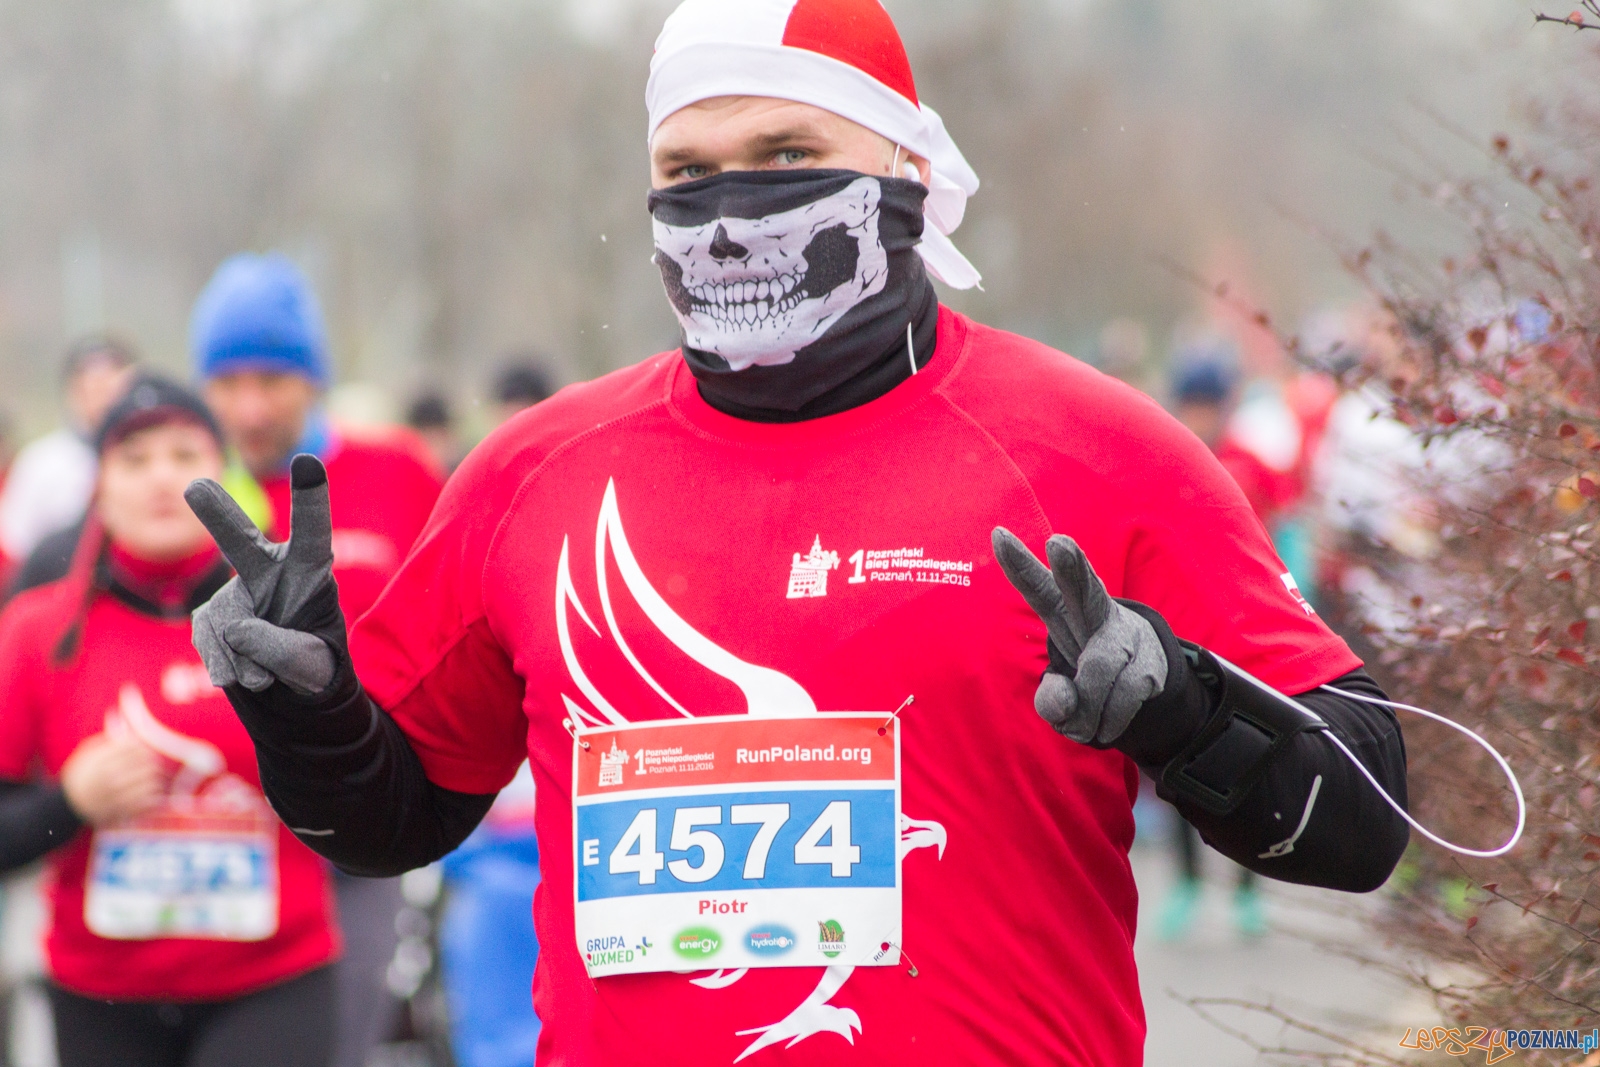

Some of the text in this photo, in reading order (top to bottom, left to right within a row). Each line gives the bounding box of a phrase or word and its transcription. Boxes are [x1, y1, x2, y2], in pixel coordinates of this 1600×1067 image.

[866, 547, 924, 560] Poznański
[848, 549, 866, 584] 1
[865, 558, 973, 572] Bieg Niepodległości
[870, 571, 971, 587] Poznań, 11.11.2016
[645, 747, 683, 756] Poznański
[736, 744, 872, 765] RunPoland.org
[634, 748, 647, 775] 1
[645, 756, 661, 765] Bieg
[679, 762, 714, 772] 11.11.2016
[583, 800, 861, 886] E 4574
[698, 899, 748, 915] Piotr
[586, 935, 626, 952] GRUPA
[679, 938, 718, 953] energy
